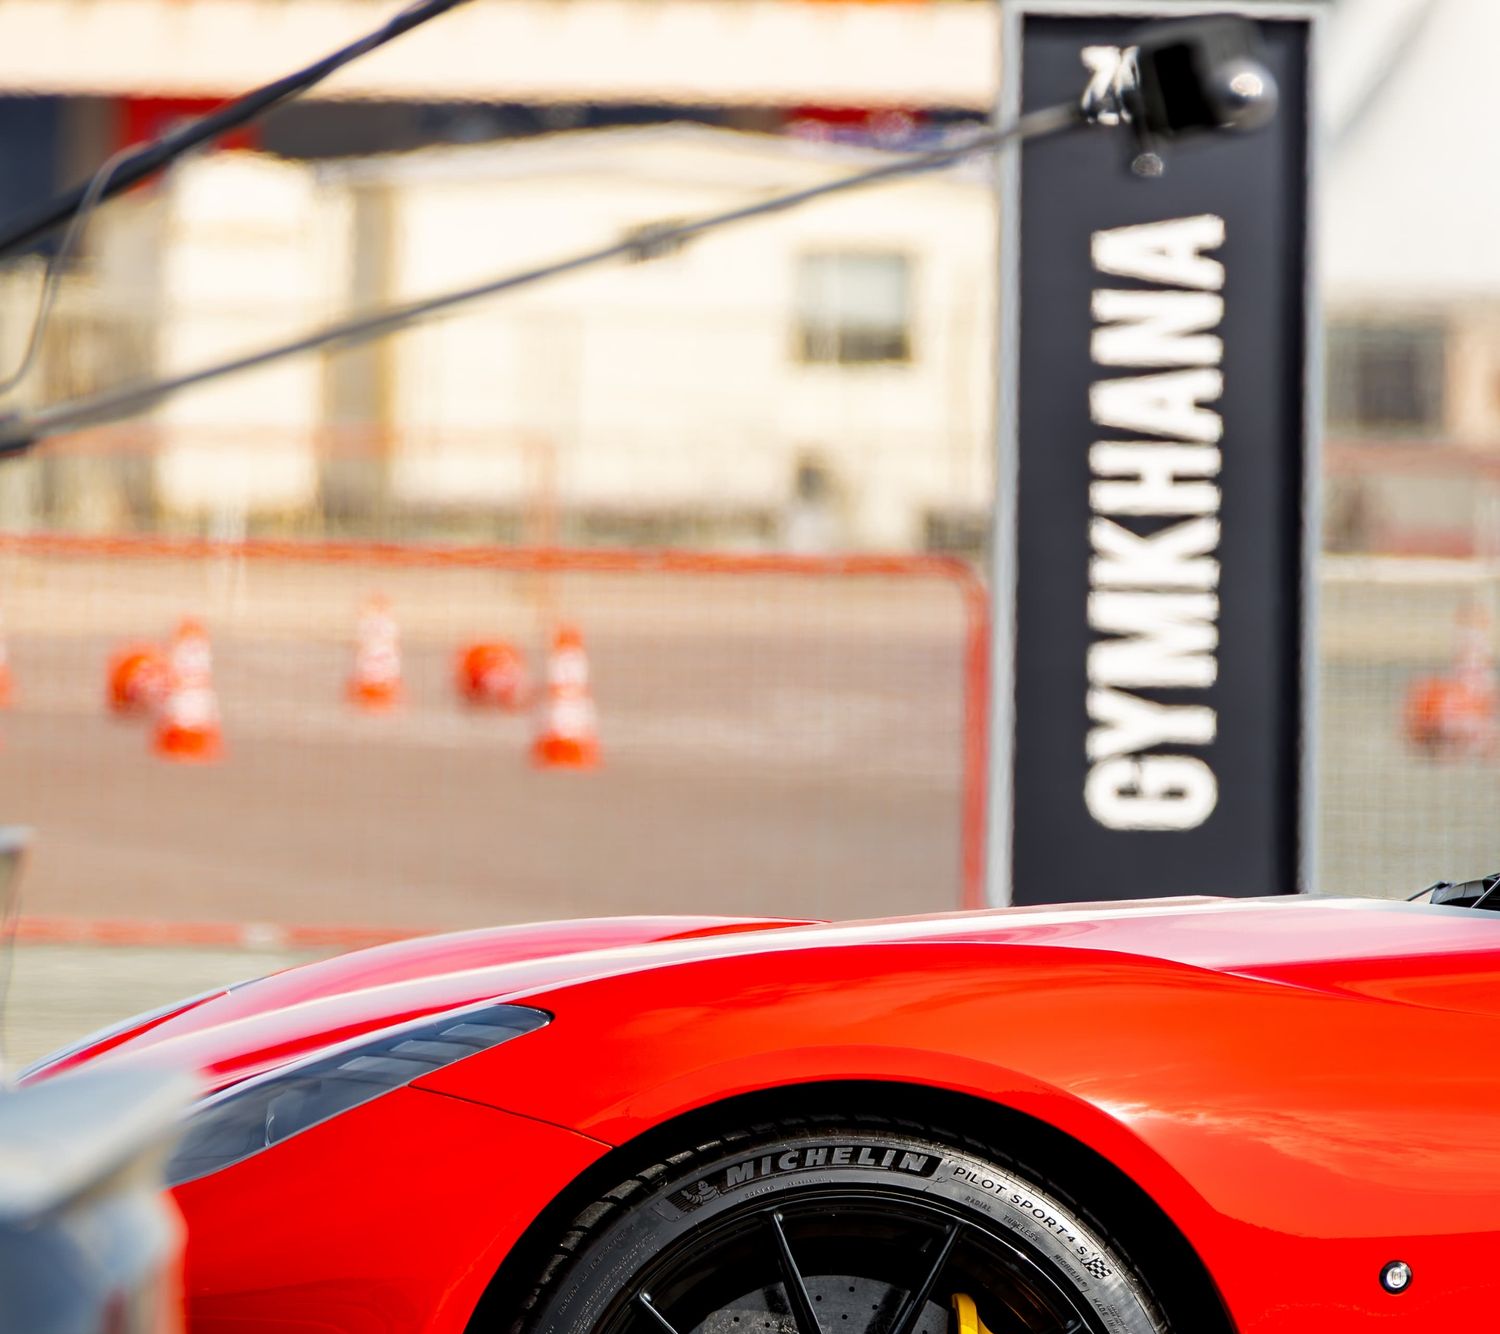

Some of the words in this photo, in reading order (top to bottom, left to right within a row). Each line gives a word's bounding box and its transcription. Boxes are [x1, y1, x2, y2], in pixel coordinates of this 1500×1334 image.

[1084, 214, 1226, 832] GYMKHANA
[726, 1147, 928, 1188] MICHELIN
[953, 1167, 1007, 1194] PILOT
[964, 1196, 991, 1212] RADIAL
[1003, 1215, 1040, 1242] TUBELESS
